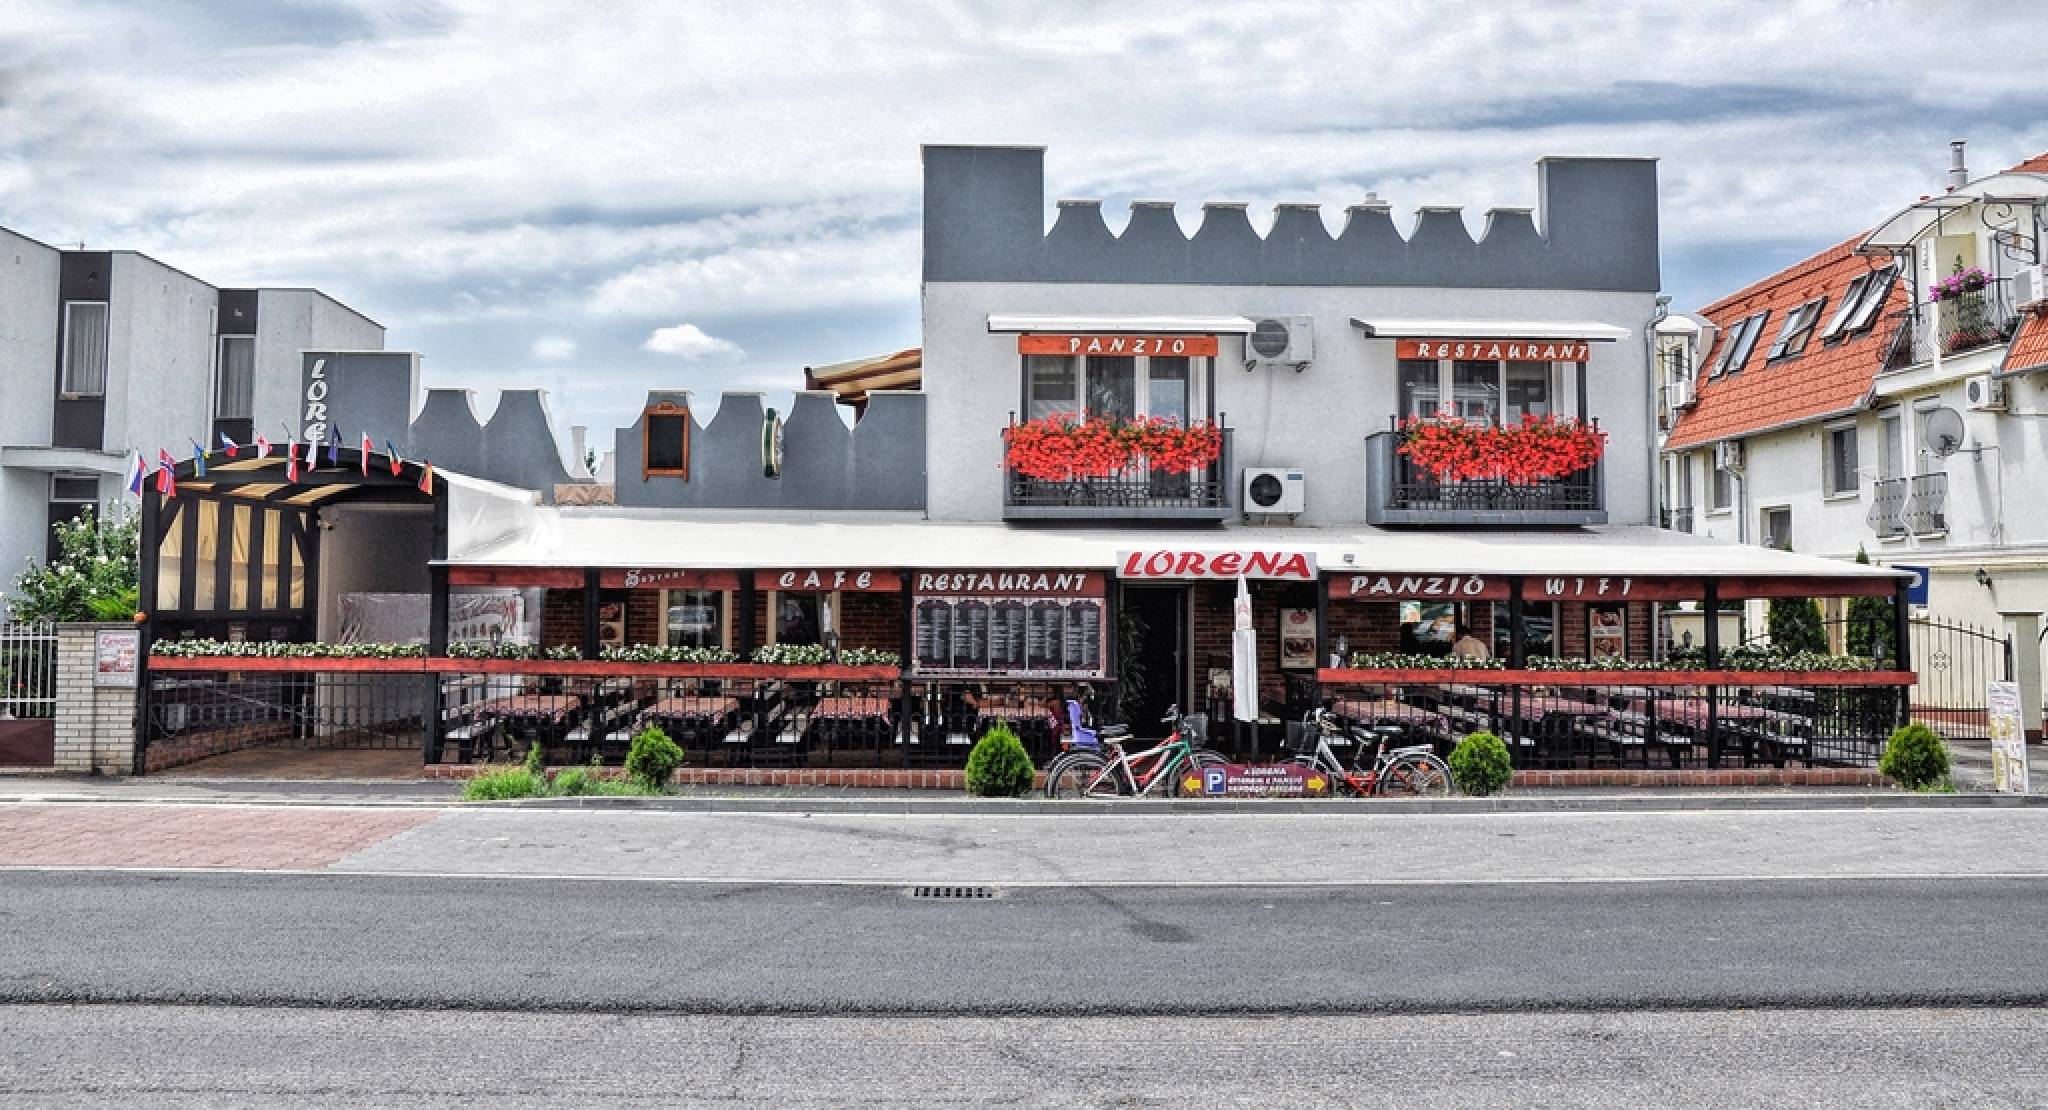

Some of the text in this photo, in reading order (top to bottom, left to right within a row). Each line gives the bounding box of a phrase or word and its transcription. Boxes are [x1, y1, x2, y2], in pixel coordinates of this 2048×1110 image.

[1417, 343, 1588, 359] RESTAURANT
[304, 359, 328, 443] LORE
[1123, 550, 1311, 577] LORENA
[779, 569, 872, 589] CAFE
[919, 573, 1087, 591] RESTAURANT
[1545, 578, 1631, 596] WIFI
[1209, 773, 1223, 791] P
